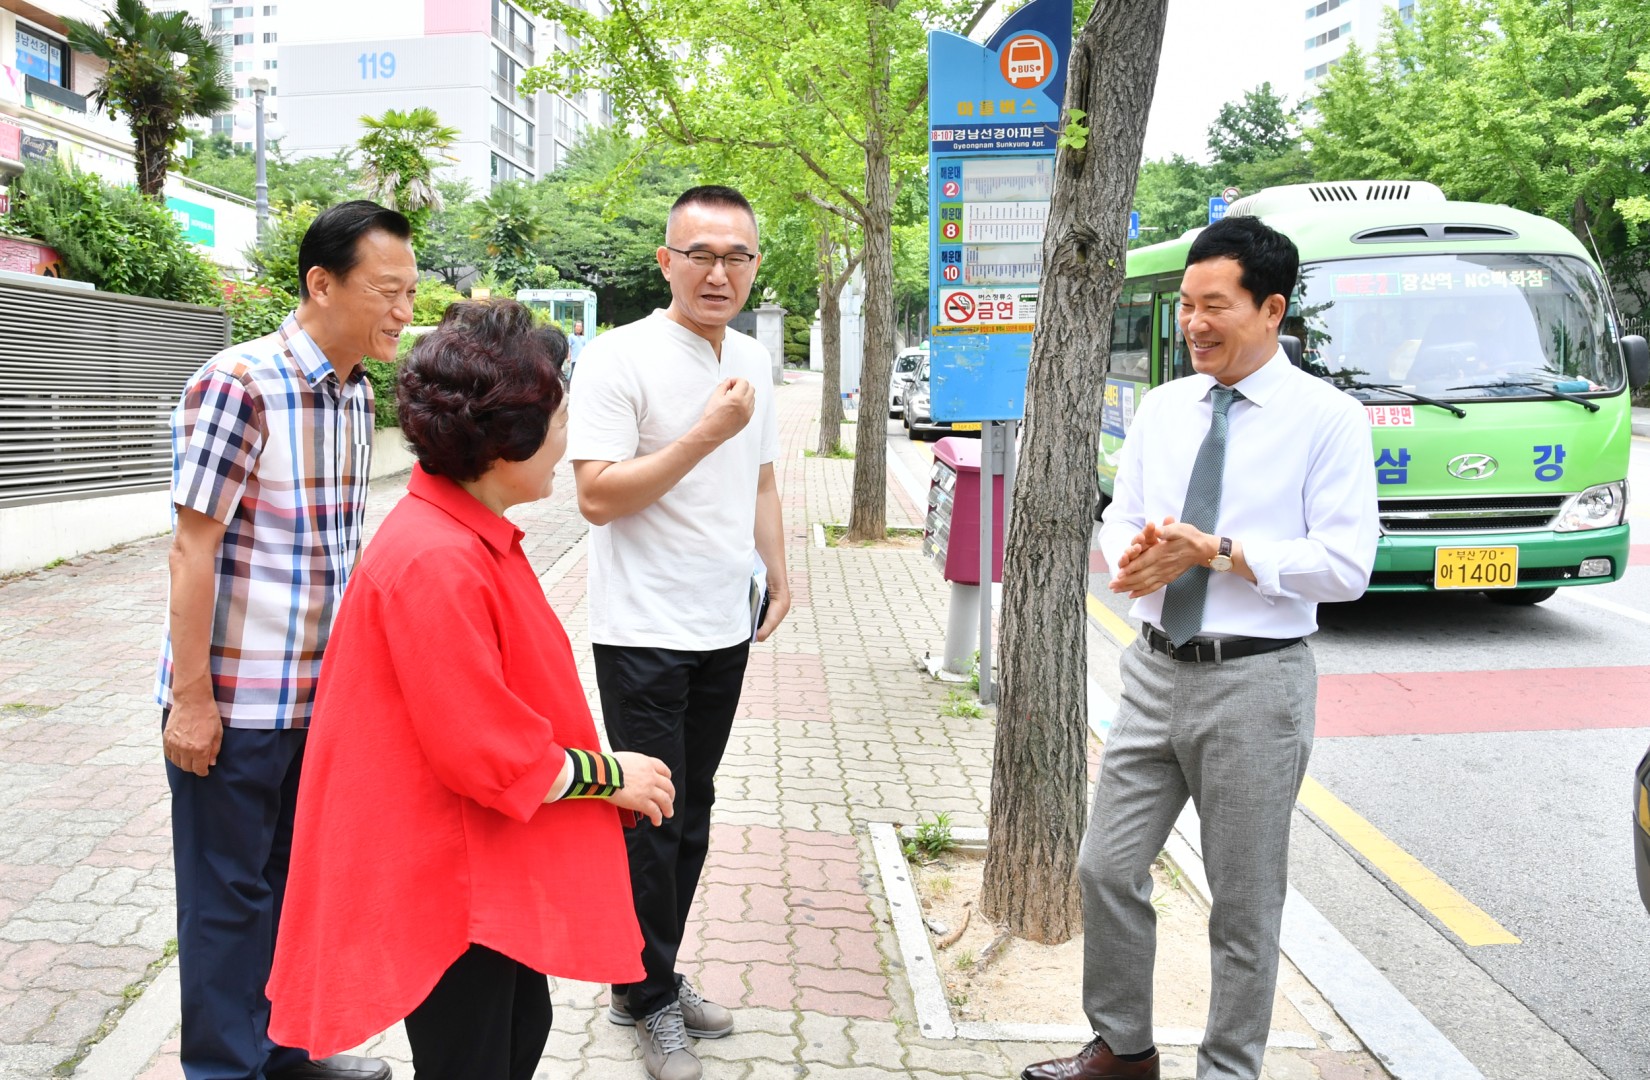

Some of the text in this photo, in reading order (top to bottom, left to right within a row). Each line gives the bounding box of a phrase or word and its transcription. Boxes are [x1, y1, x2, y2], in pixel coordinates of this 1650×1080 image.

[358, 51, 396, 79] 119
[1018, 64, 1035, 73] BUS
[957, 98, 1037, 117] 마을버스
[954, 127, 1045, 141] 경남선경아파트
[953, 140, 1046, 150] Gyeongnam Sunkyung Apt.
[940, 166, 961, 180] 해운대
[945, 183, 956, 196] 2
[941, 207, 962, 221] 해운대
[946, 224, 956, 237] 8
[941, 250, 962, 264] 해운대
[944, 266, 958, 280] 10
[977, 301, 1013, 320] 금연
[1389, 406, 1412, 425] 방면
[1374, 444, 1566, 485] 삼 강
[1456, 550, 1497, 561] 부산 70
[1440, 562, 1511, 583] 아 1400
